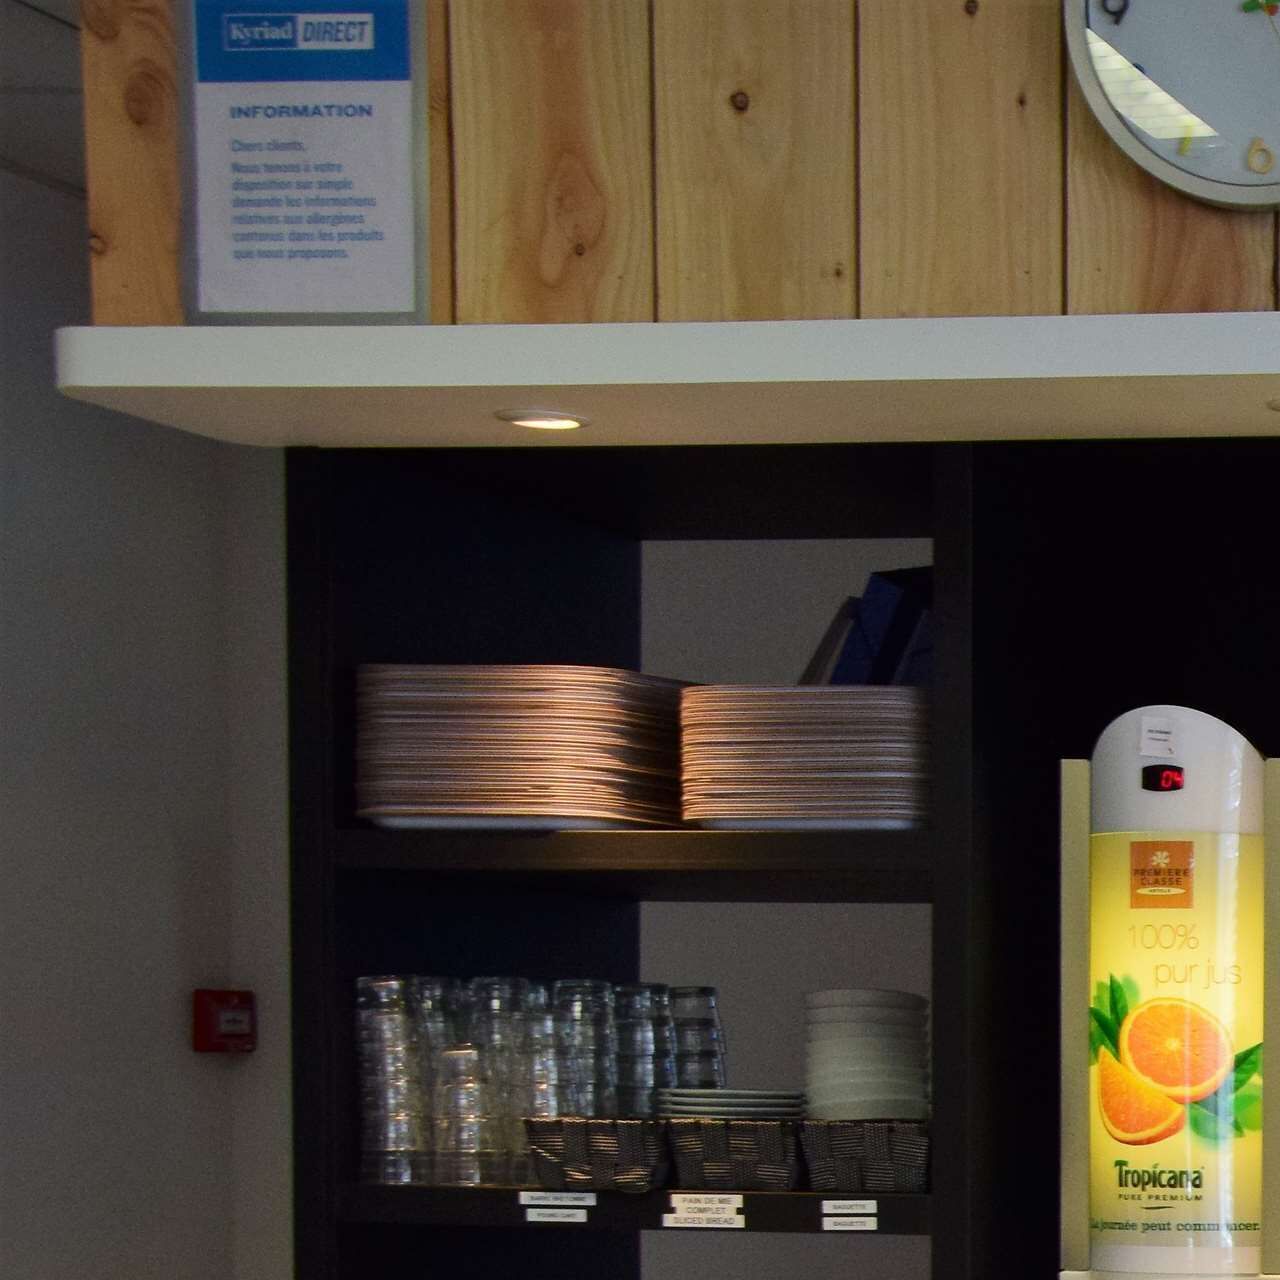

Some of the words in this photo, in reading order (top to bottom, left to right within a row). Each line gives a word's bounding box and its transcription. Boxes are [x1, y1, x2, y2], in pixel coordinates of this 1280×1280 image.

[230, 21, 293, 43] Kyriad
[302, 21, 369, 42] DIRECT
[229, 104, 374, 120] INFORMATION
[1246, 137, 1276, 175] 6
[1140, 877, 1184, 887] CLASSE
[1127, 922, 1201, 951] 100%
[1153, 962, 1201, 991] pur
[1203, 956, 1244, 991] jus
[1113, 1160, 1203, 1193] Tropicana
[1118, 1193, 1144, 1202] PURE
[1146, 1193, 1205, 1202] PREMIUM
[1140, 1221, 1172, 1234] peut
[1175, 1220, 1262, 1232] commncer.
